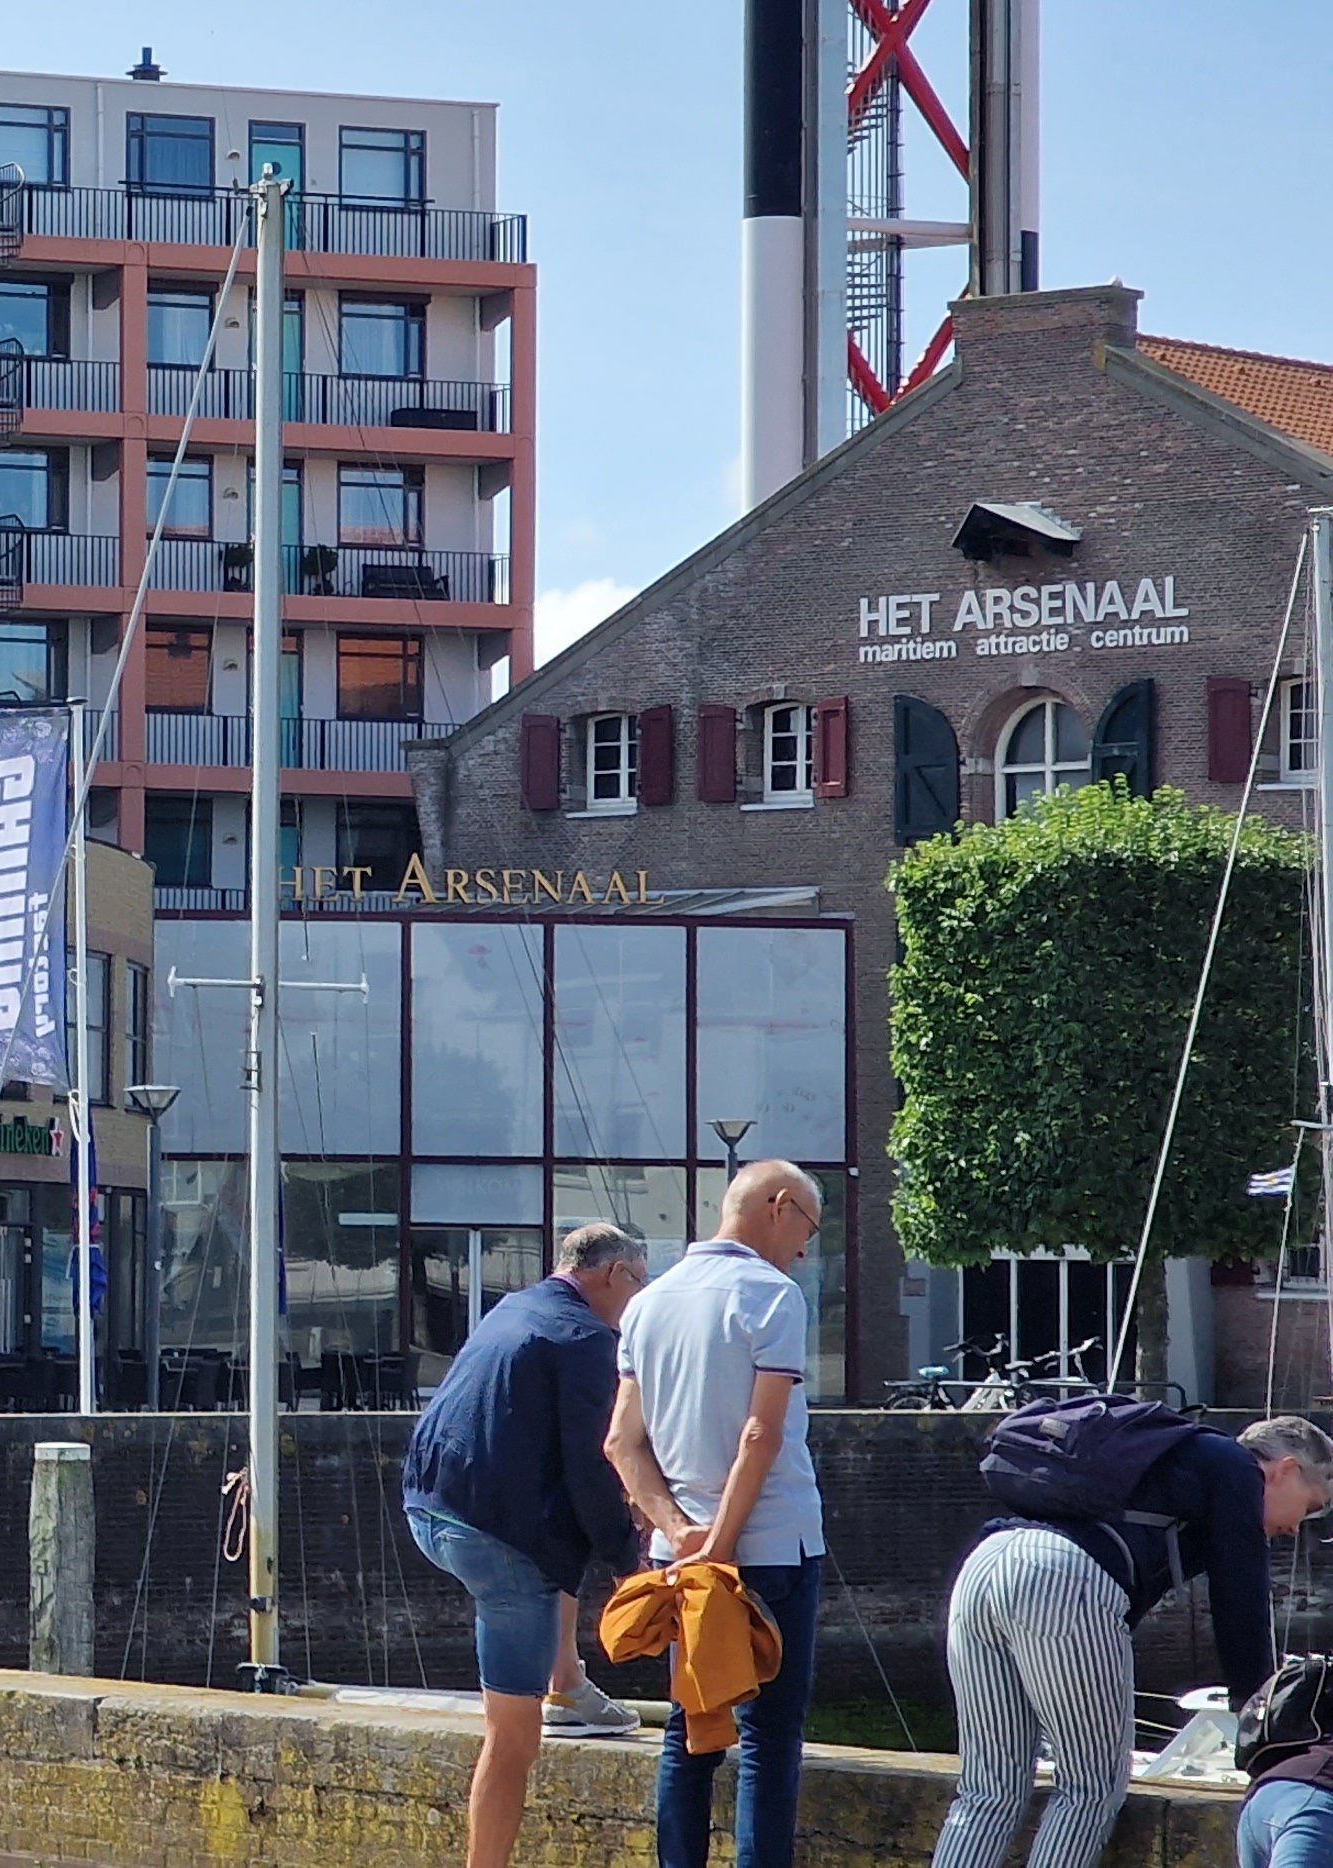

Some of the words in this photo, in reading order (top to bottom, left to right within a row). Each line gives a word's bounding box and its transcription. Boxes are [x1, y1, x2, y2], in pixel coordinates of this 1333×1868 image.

[859, 592, 940, 637] HET
[952, 575, 1189, 632] ARSENAAL
[859, 637, 957, 663] maritiem
[975, 628, 1069, 656] attractie
[1091, 624, 1189, 648] centrum
[278, 866, 373, 902] HET
